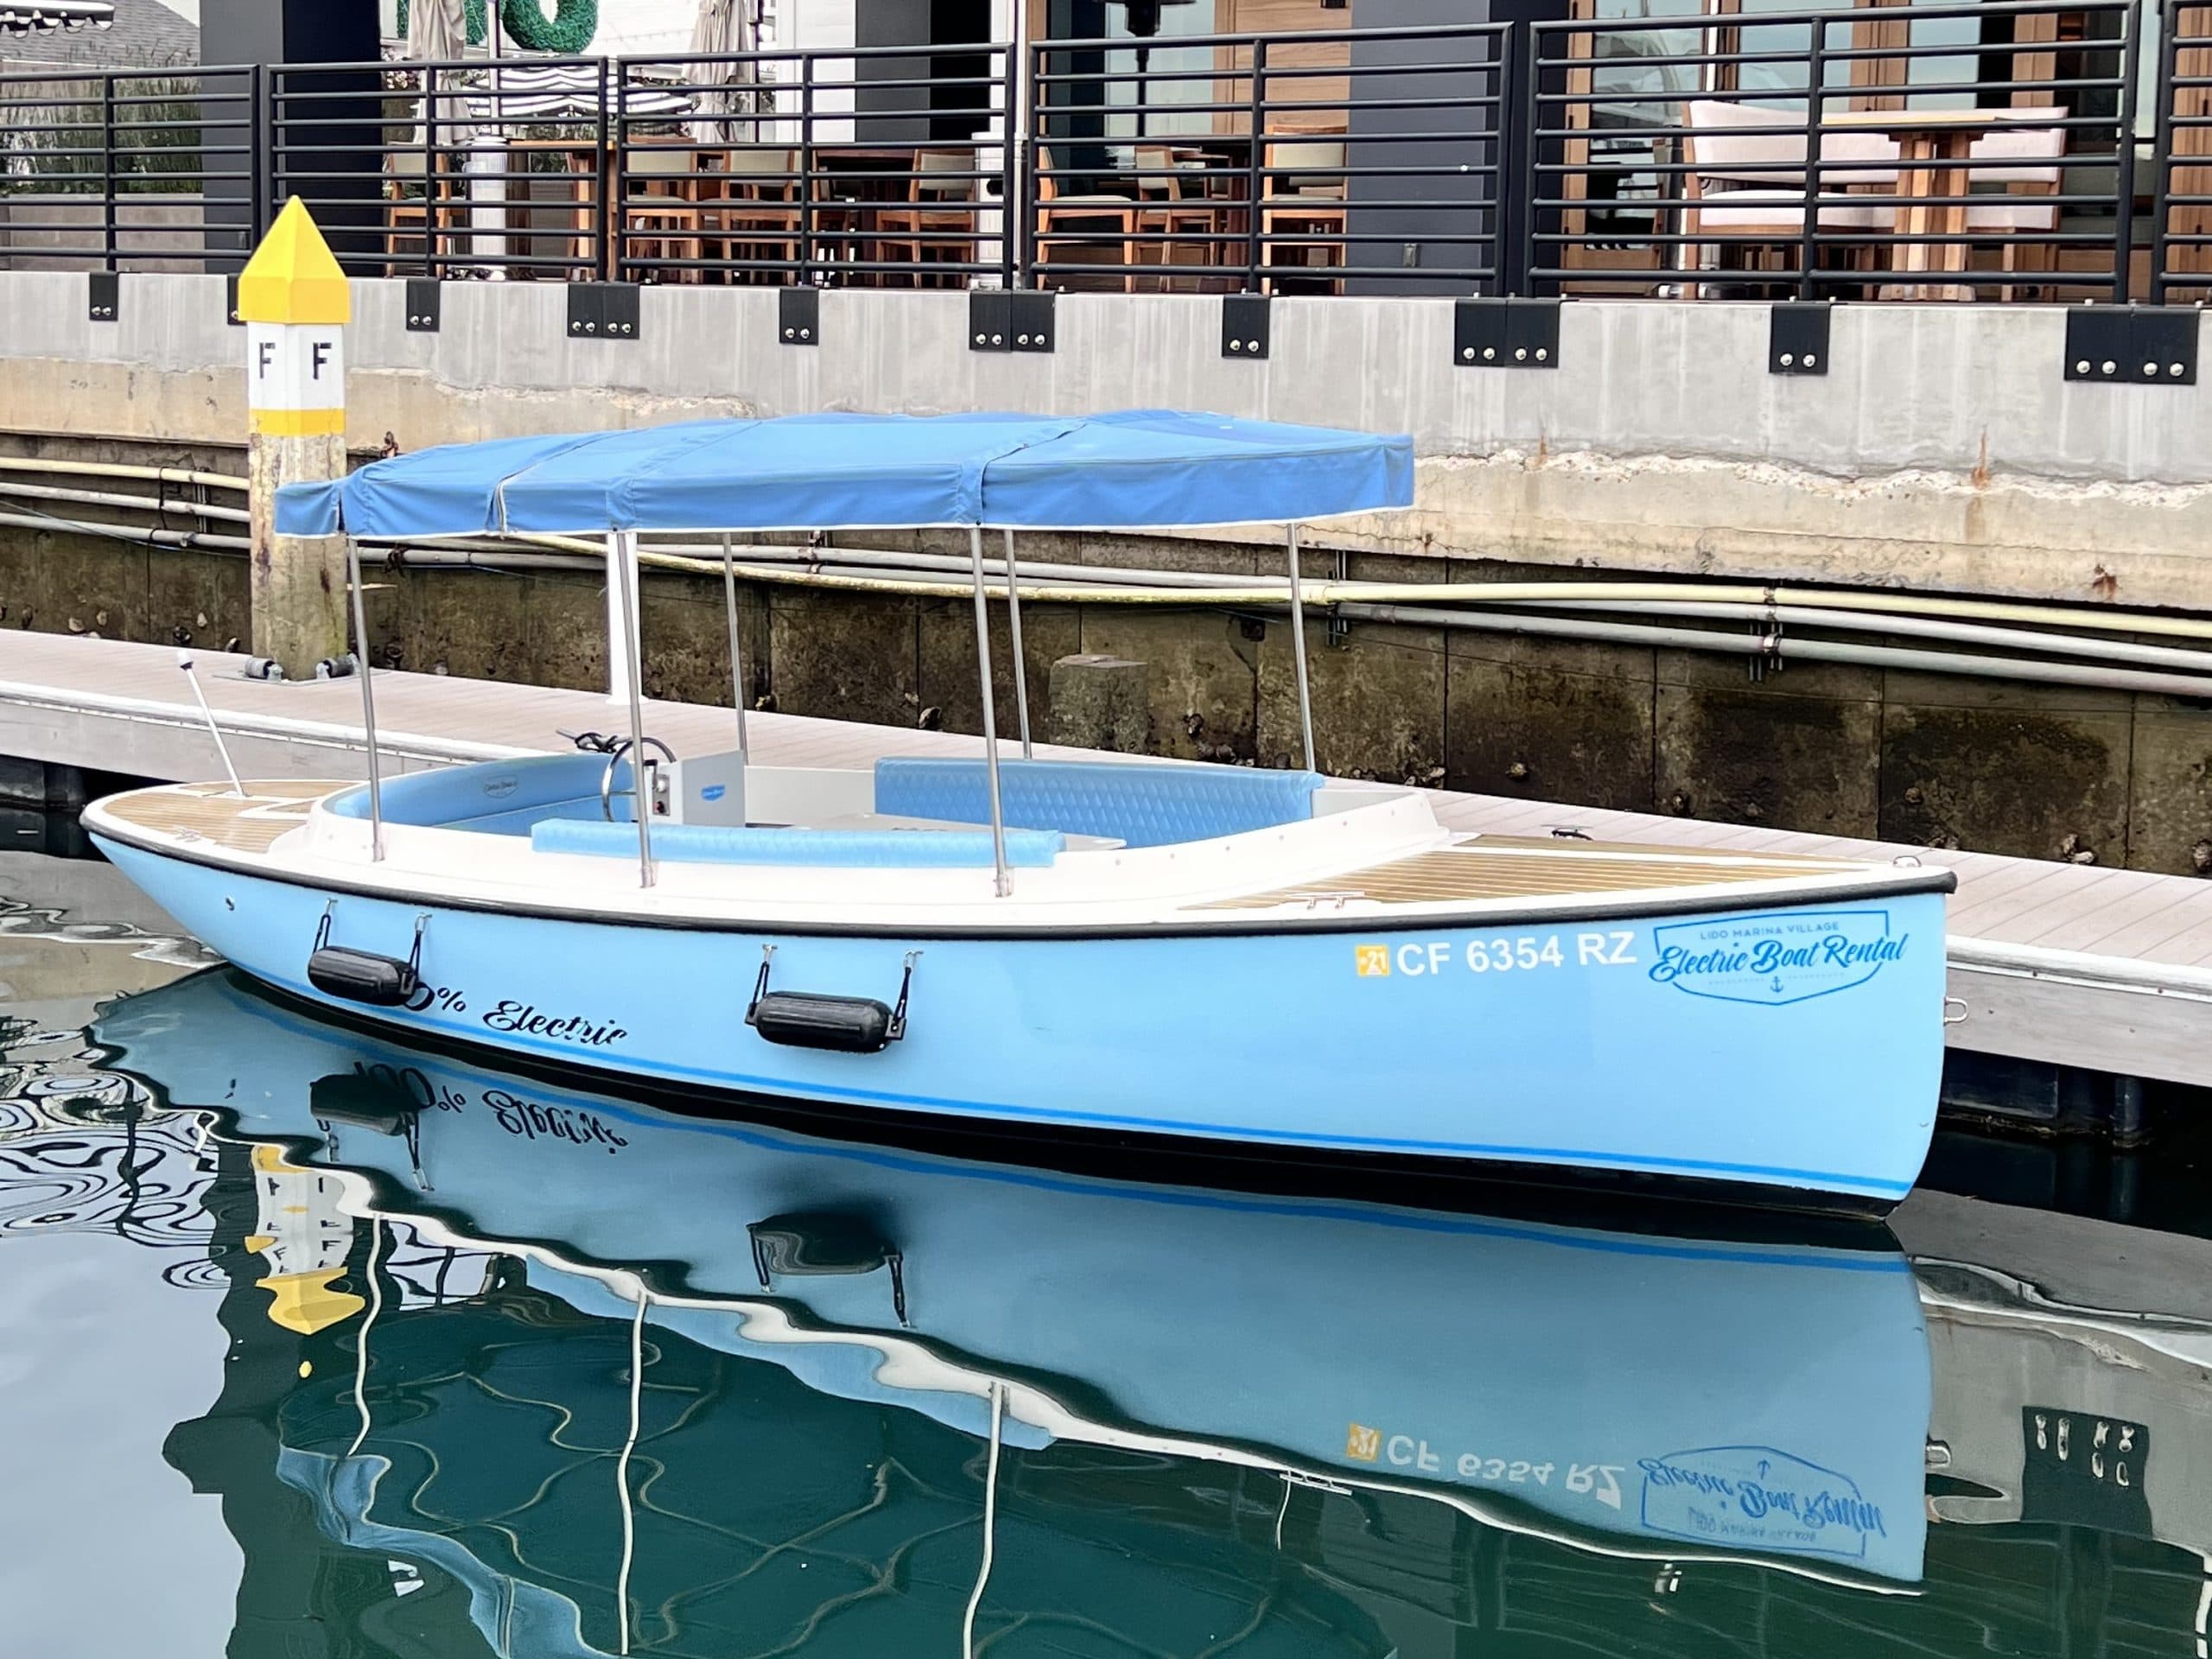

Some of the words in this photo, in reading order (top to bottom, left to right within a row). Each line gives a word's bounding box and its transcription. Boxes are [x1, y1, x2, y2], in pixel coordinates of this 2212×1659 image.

[258, 342, 276, 379] F
[313, 342, 332, 380] F
[1700, 930, 1728, 940] LIDO
[1733, 926, 1783, 938] MARINA
[1787, 921, 1840, 933] VILLAGE
[1396, 942, 1451, 976] CF
[1466, 935, 1565, 973] 6354
[1577, 931, 1637, 966] RZ
[1649, 942, 1748, 982] Electric
[1751, 939, 1820, 974] Boat
[1822, 933, 1909, 968] Rental
[482, 1001, 628, 1046] Electric
